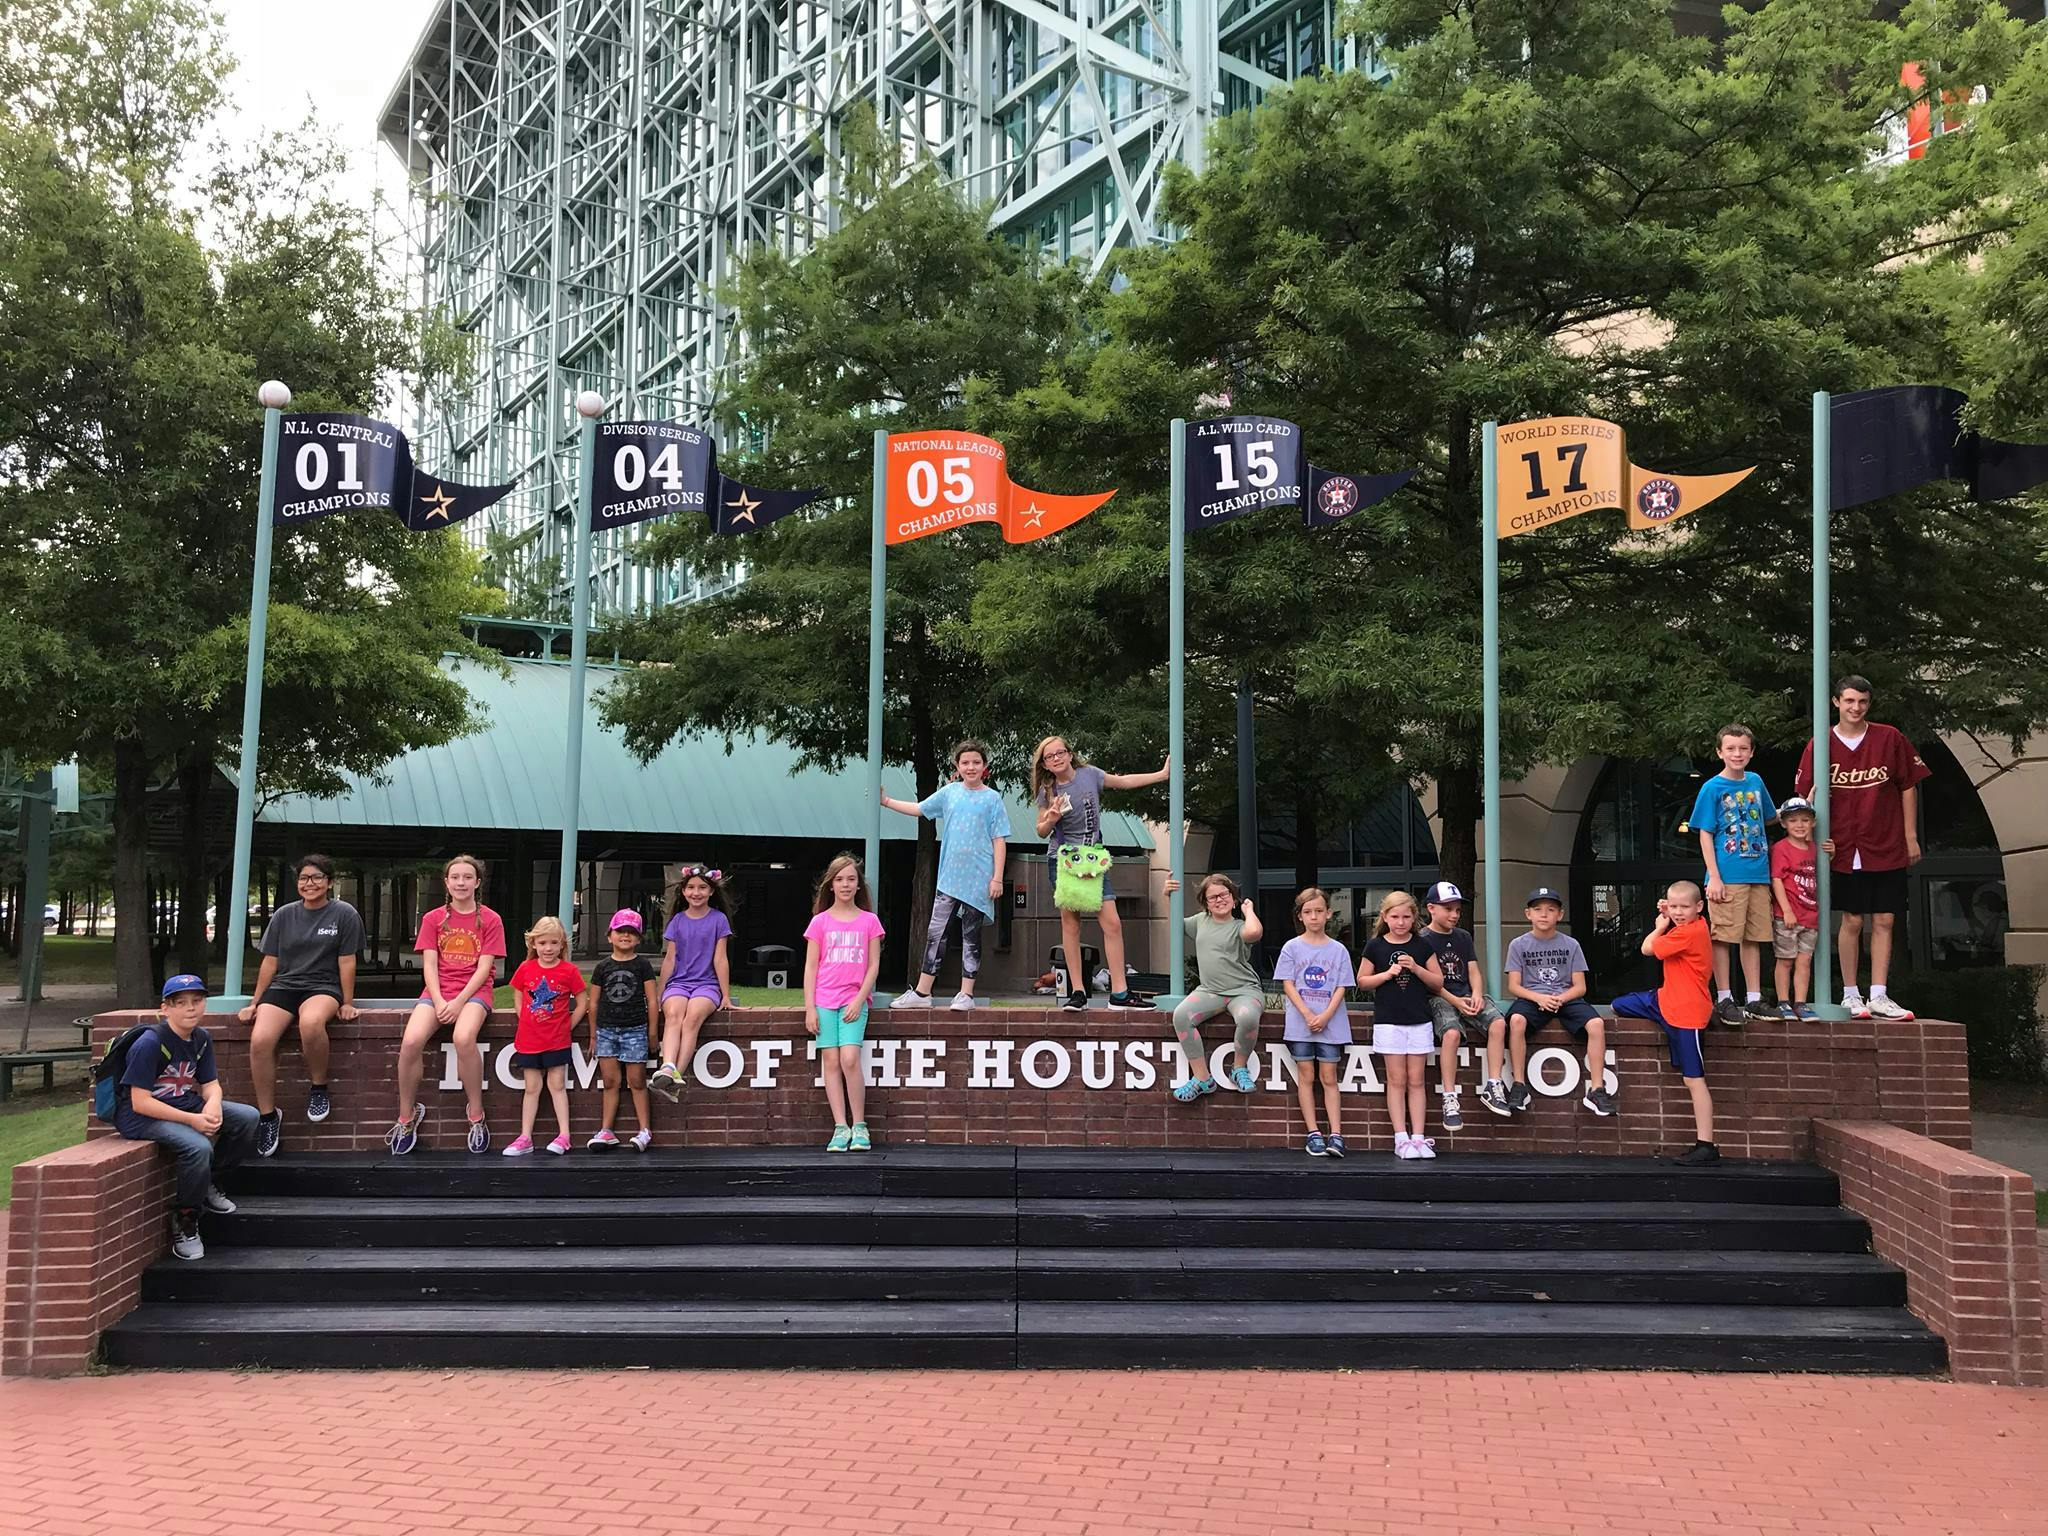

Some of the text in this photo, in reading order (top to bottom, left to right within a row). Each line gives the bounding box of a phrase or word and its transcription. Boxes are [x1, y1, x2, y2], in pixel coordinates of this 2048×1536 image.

[284, 421, 393, 449] N.L. CENTRAL
[602, 425, 701, 445] DIVISION SERIES
[1197, 423, 1291, 437] A.L. WILD CARD
[1501, 424, 1615, 444] WORLD SERIES
[893, 439, 1005, 461] NATIONAL LEAGUE
[295, 442, 363, 491] 01
[613, 443, 683, 492] 04
[1213, 440, 1279, 491] 15
[1521, 442, 1588, 500] 17
[906, 456, 974, 508] 05
[1642, 480, 1675, 494] HOUSTON
[282, 492, 391, 517] CHAMPIONS
[602, 491, 705, 518] CHAMPIONS
[1200, 485, 1301, 518] CHAMPIONS
[1510, 489, 1617, 530] CHAMPIONS
[1645, 506, 1675, 518] ASTROS
[898, 502, 998, 536] CHAMPIONS
[1016, 894, 1025, 904] 38
[1447, 885, 1458, 896] T
[1595, 892, 1607, 901] FOR
[1595, 902, 1610, 912] YOU.
[1522, 948, 1570, 959] abercrombie
[1546, 957, 1567, 965] 1892
[1305, 974, 1327, 983] NASA
[438, 1042, 665, 1090] HOM
[692, 1039, 792, 1089] OF
[967, 1039, 1300, 1091] HOUSTON
[1338, 1046, 1619, 1097] ATROS
